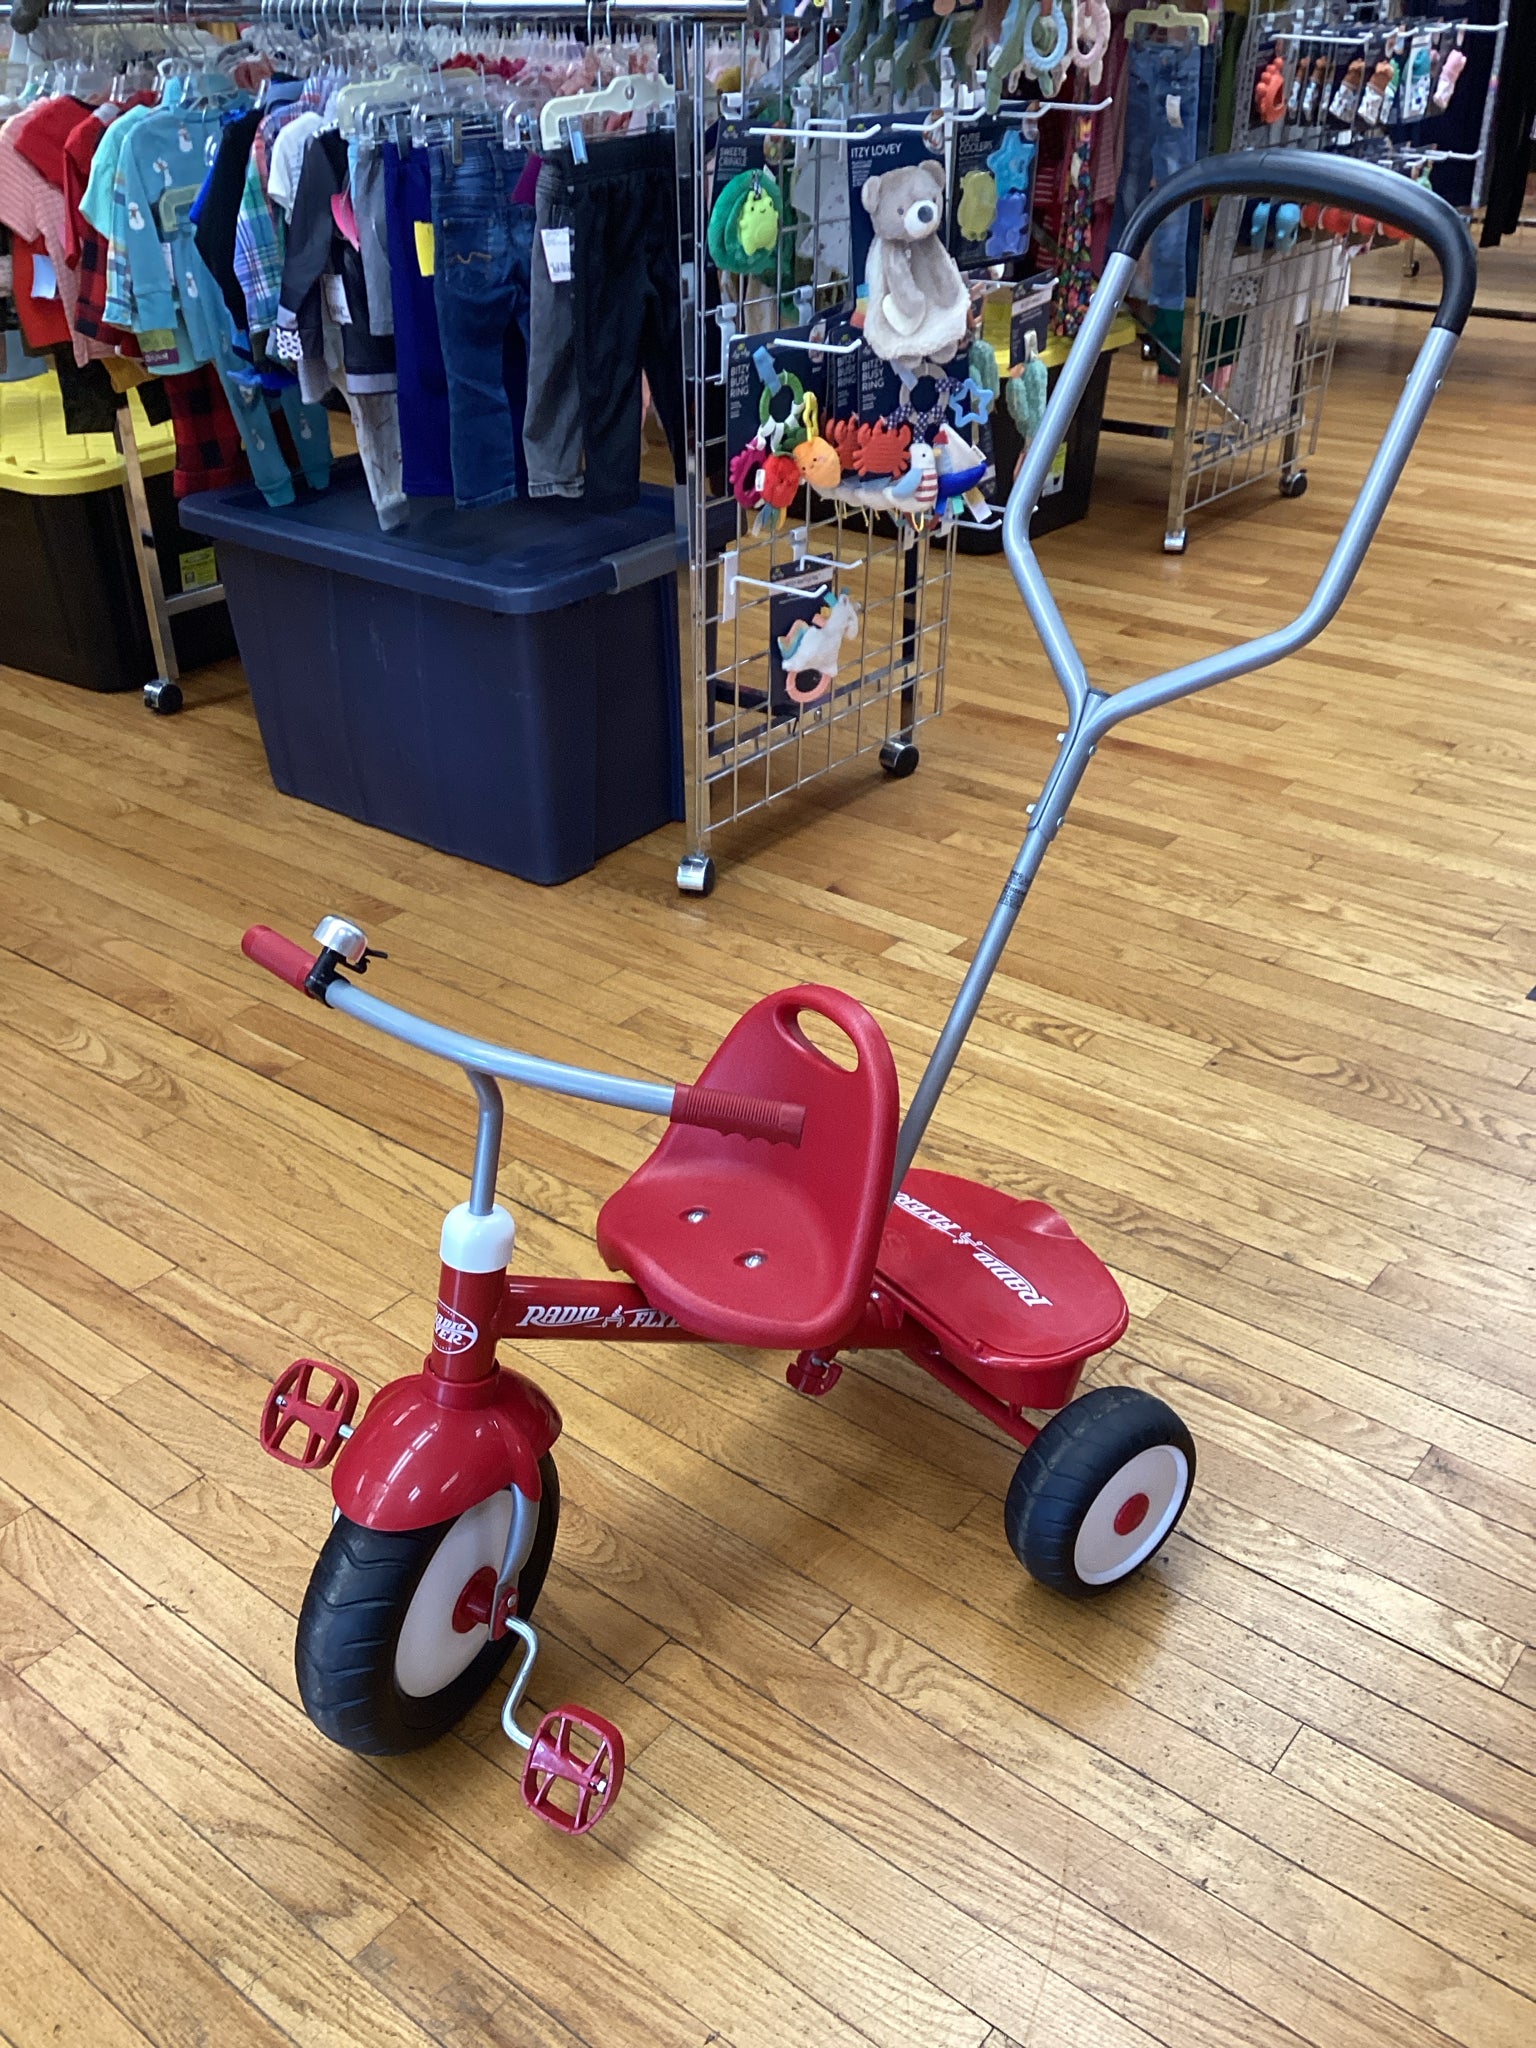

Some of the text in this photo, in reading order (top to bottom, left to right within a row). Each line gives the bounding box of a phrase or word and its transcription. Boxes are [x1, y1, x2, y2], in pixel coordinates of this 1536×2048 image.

[851, 143, 902, 158] ITZY LOVEY
[730, 364, 750, 377] BITZY
[862, 359, 884, 371] BITZY
[837, 374, 856, 388] RING
[862, 367, 884, 381] BUSY
[730, 375, 750, 388] BUSY
[862, 378, 885, 391] RING
[730, 386, 749, 398] RING
[893, 1191, 1053, 1307] RADIO FLYER
[434, 1313, 467, 1331] ADIO
[515, 1305, 681, 1328] RADIO FLY
